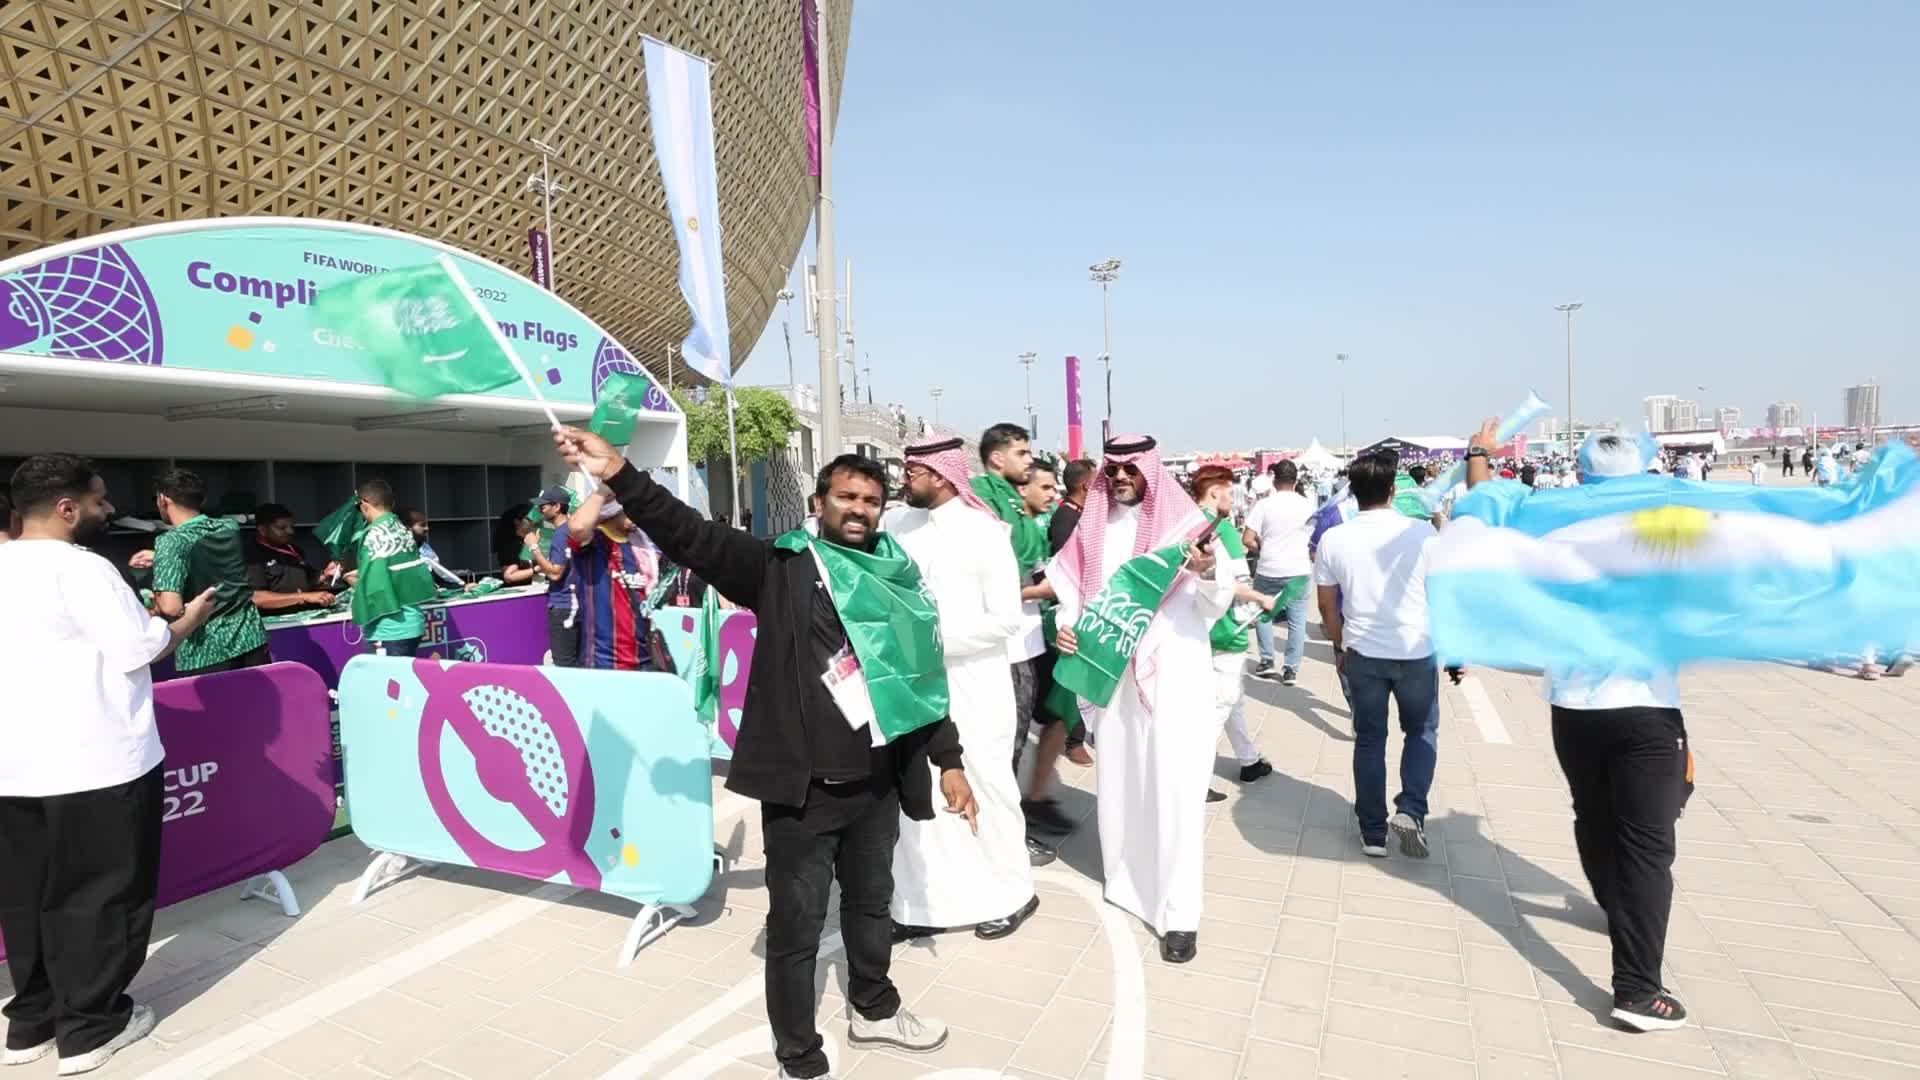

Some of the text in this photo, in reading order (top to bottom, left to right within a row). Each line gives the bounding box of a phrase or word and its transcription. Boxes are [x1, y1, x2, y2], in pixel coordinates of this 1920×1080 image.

[303, 251, 338, 269] FIFA
[474, 287, 508, 303] 2022
[187, 260, 318, 309] Compli
[523, 321, 578, 352] Flags
[163, 761, 219, 792] CUP
[162, 790, 206, 823] 22
